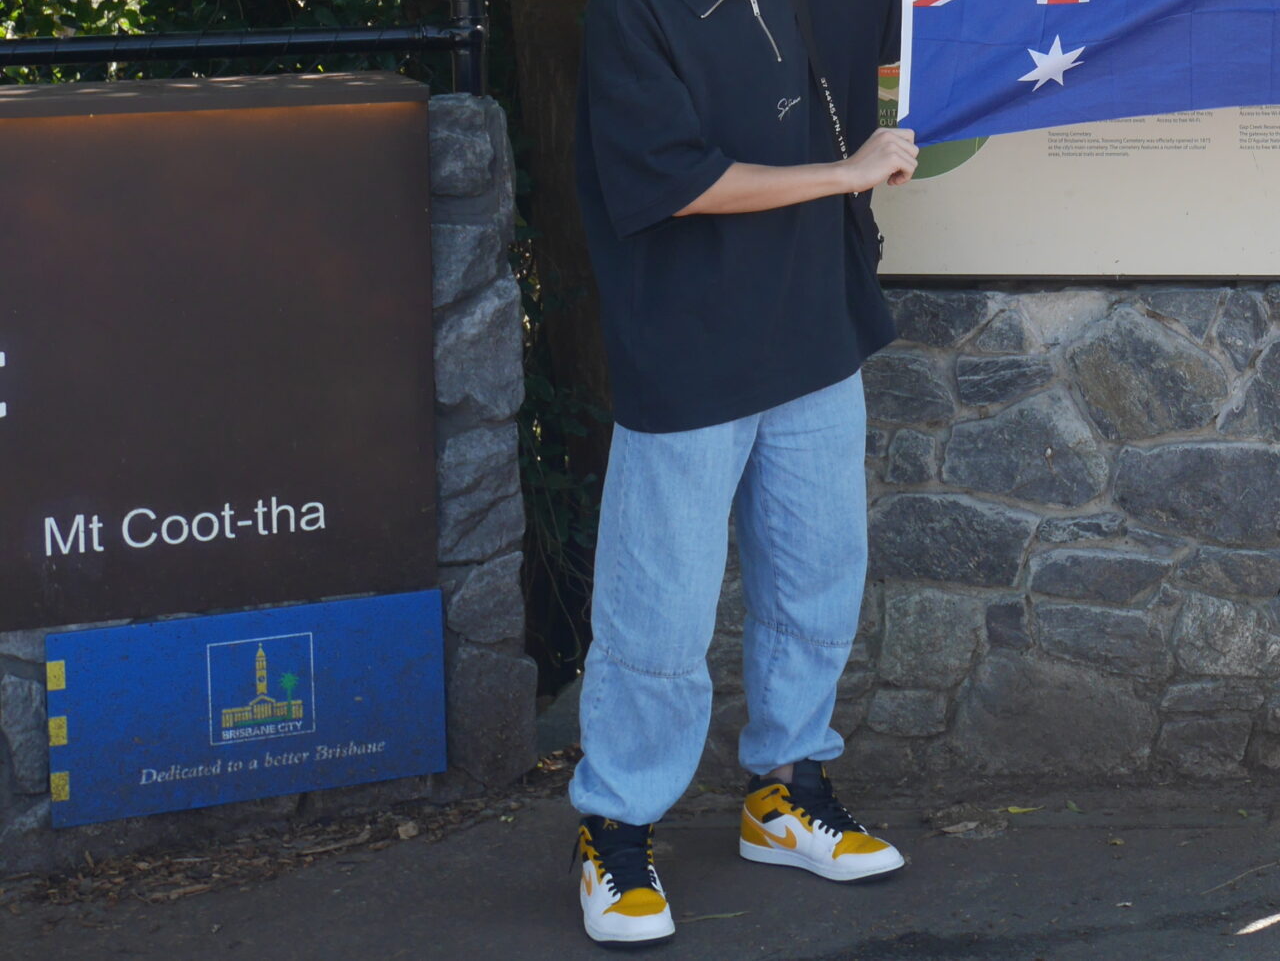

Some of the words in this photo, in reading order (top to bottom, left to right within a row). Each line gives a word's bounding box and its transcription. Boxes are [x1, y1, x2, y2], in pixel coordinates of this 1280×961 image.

[879, 108, 897, 117] MIT
[44, 514, 104, 557] Mt
[121, 496, 327, 550] Coot-tha
[222, 723, 277, 741] BRISBANE
[278, 720, 303, 733] CITY
[139, 758, 222, 786] Dedicated
[227, 759, 243, 771] to
[249, 759, 259, 770] a
[264, 748, 310, 768] better
[314, 739, 387, 762] Brisbane
